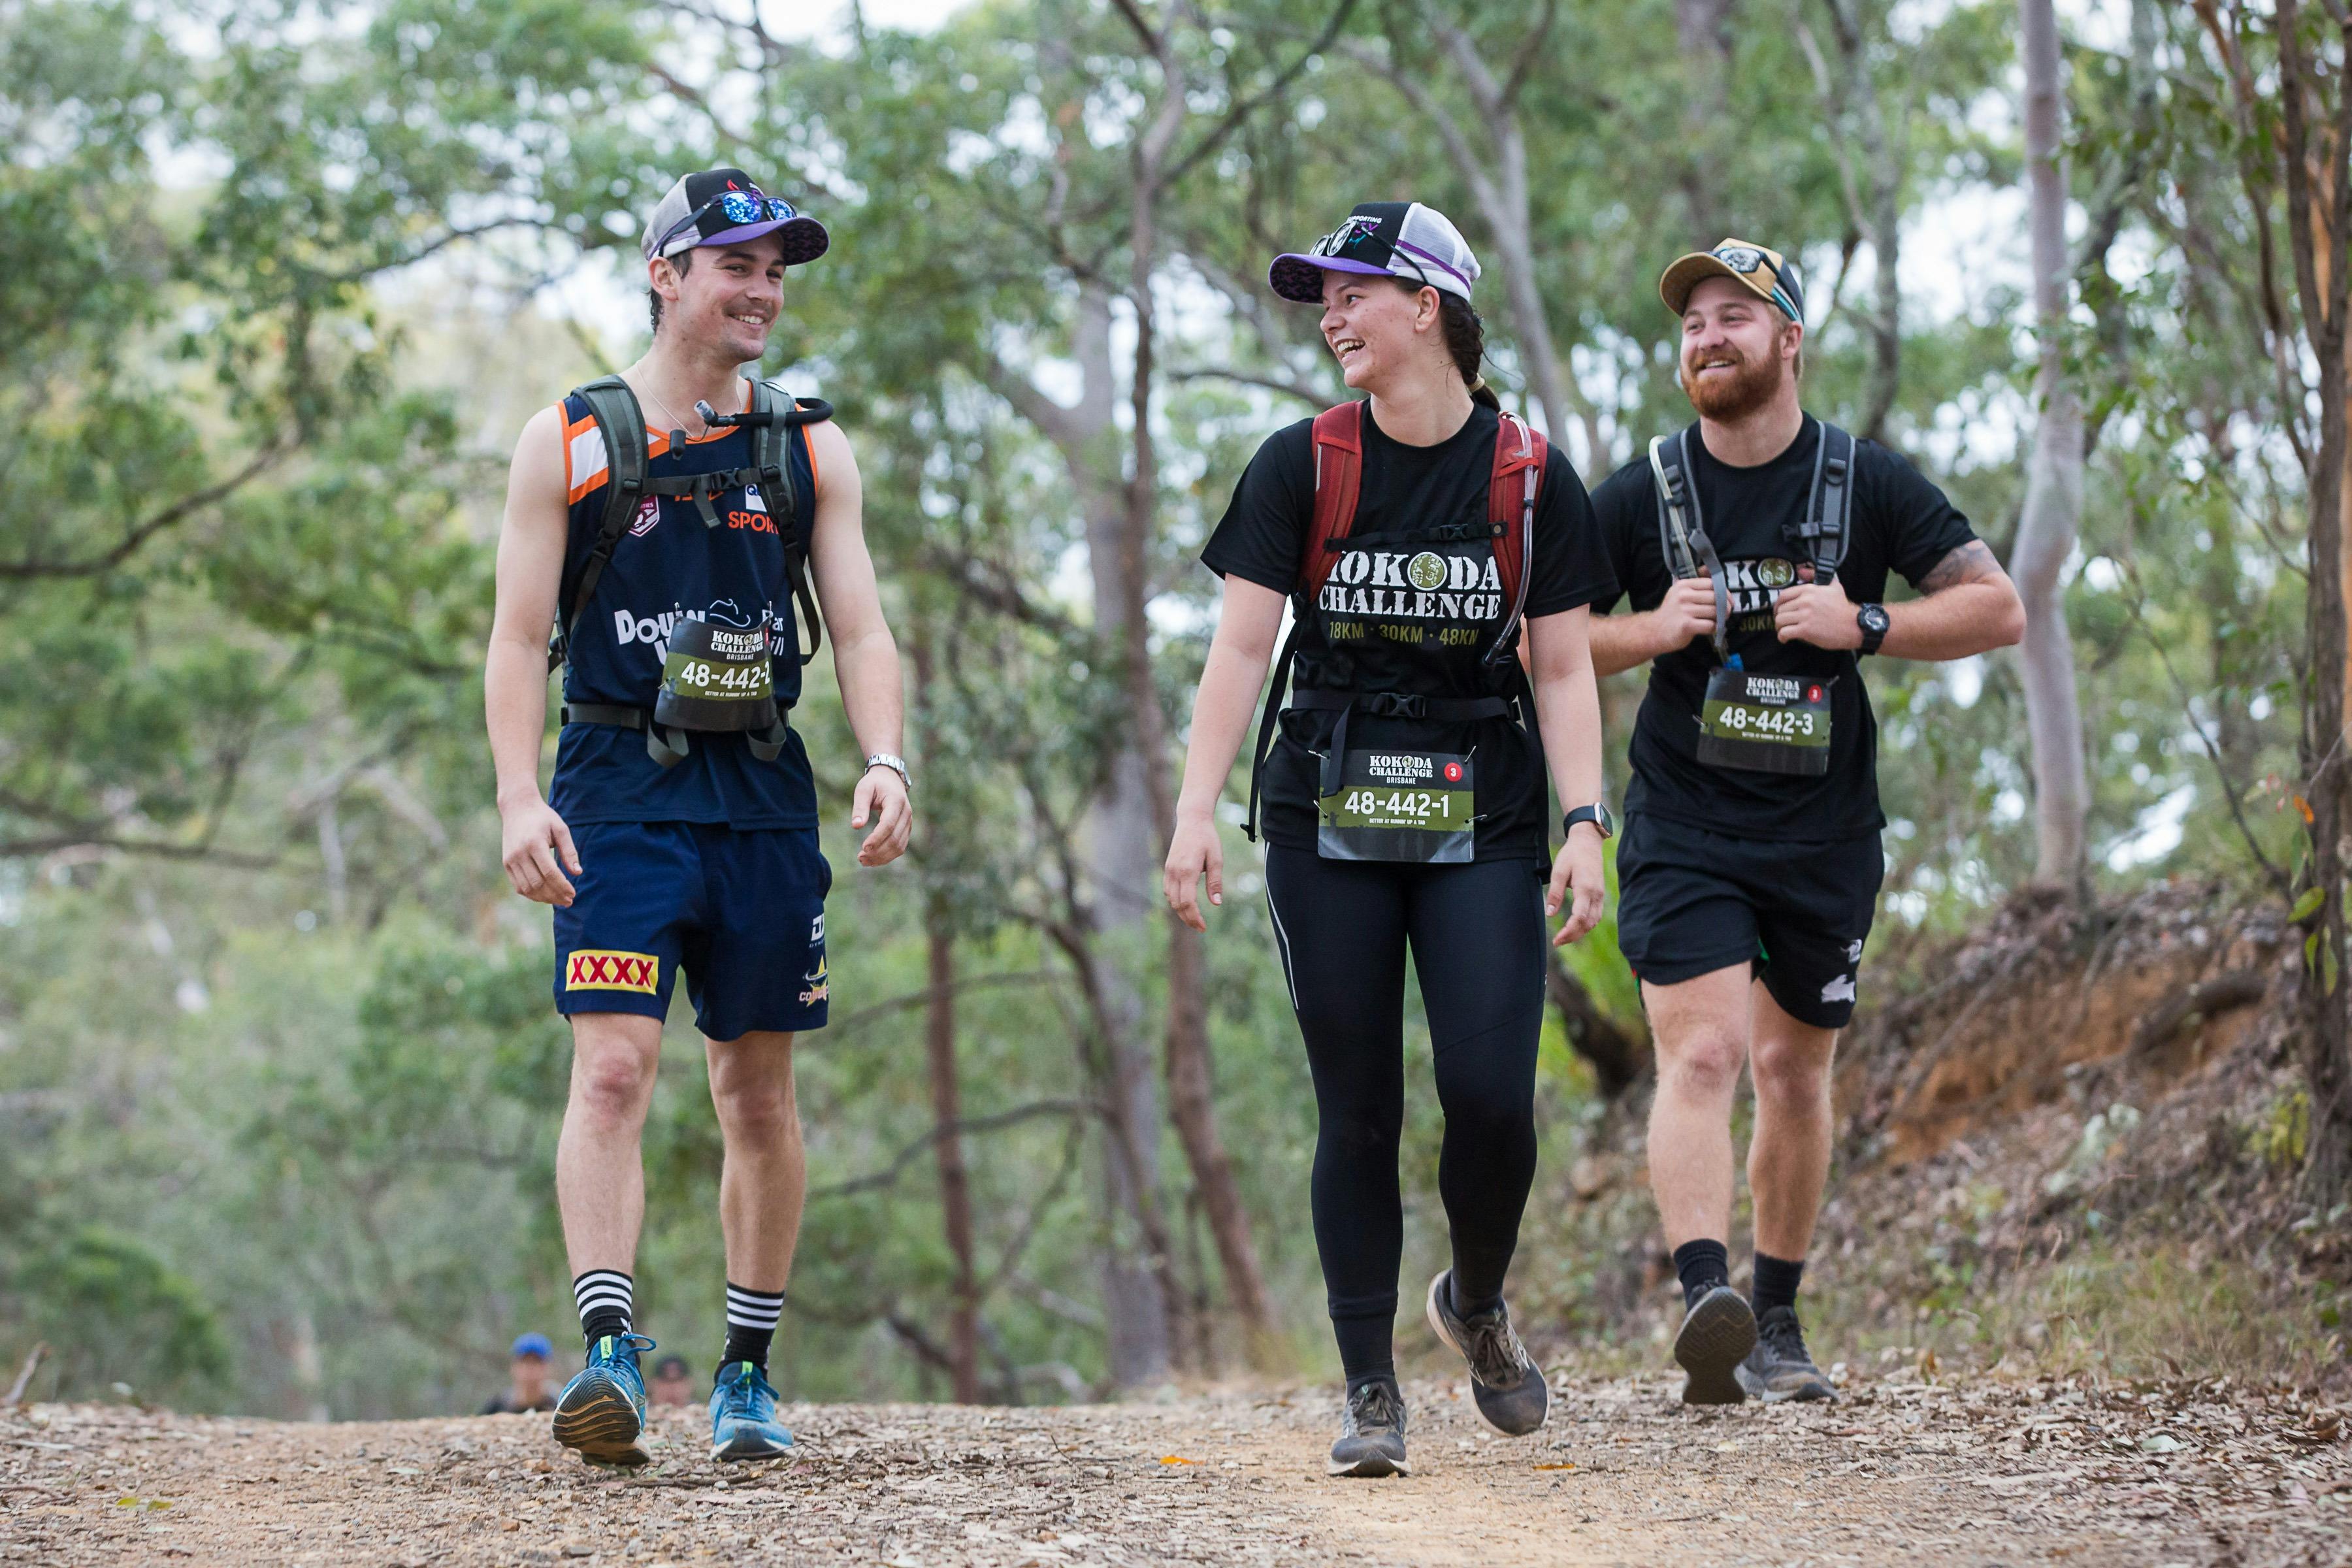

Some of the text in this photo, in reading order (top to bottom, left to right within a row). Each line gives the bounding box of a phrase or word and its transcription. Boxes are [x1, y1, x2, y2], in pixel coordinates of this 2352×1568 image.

[1318, 585, 1501, 619] CHALLENGE
[1330, 621, 1364, 639] 18KM
[1379, 624, 1423, 644] 30KM
[711, 642, 764, 653] CHALLENGE
[681, 661, 770, 689] 48-442-2
[1746, 687, 1800, 699] CHALLENGE
[1720, 706, 1814, 735] 48-442-3
[1369, 767, 1433, 778] CHALLENGE
[1386, 776, 1416, 785] BRISBANE
[1450, 767, 1457, 777] 3
[1345, 791, 1449, 817] 48-442-1
[570, 956, 653, 988] XXXX
